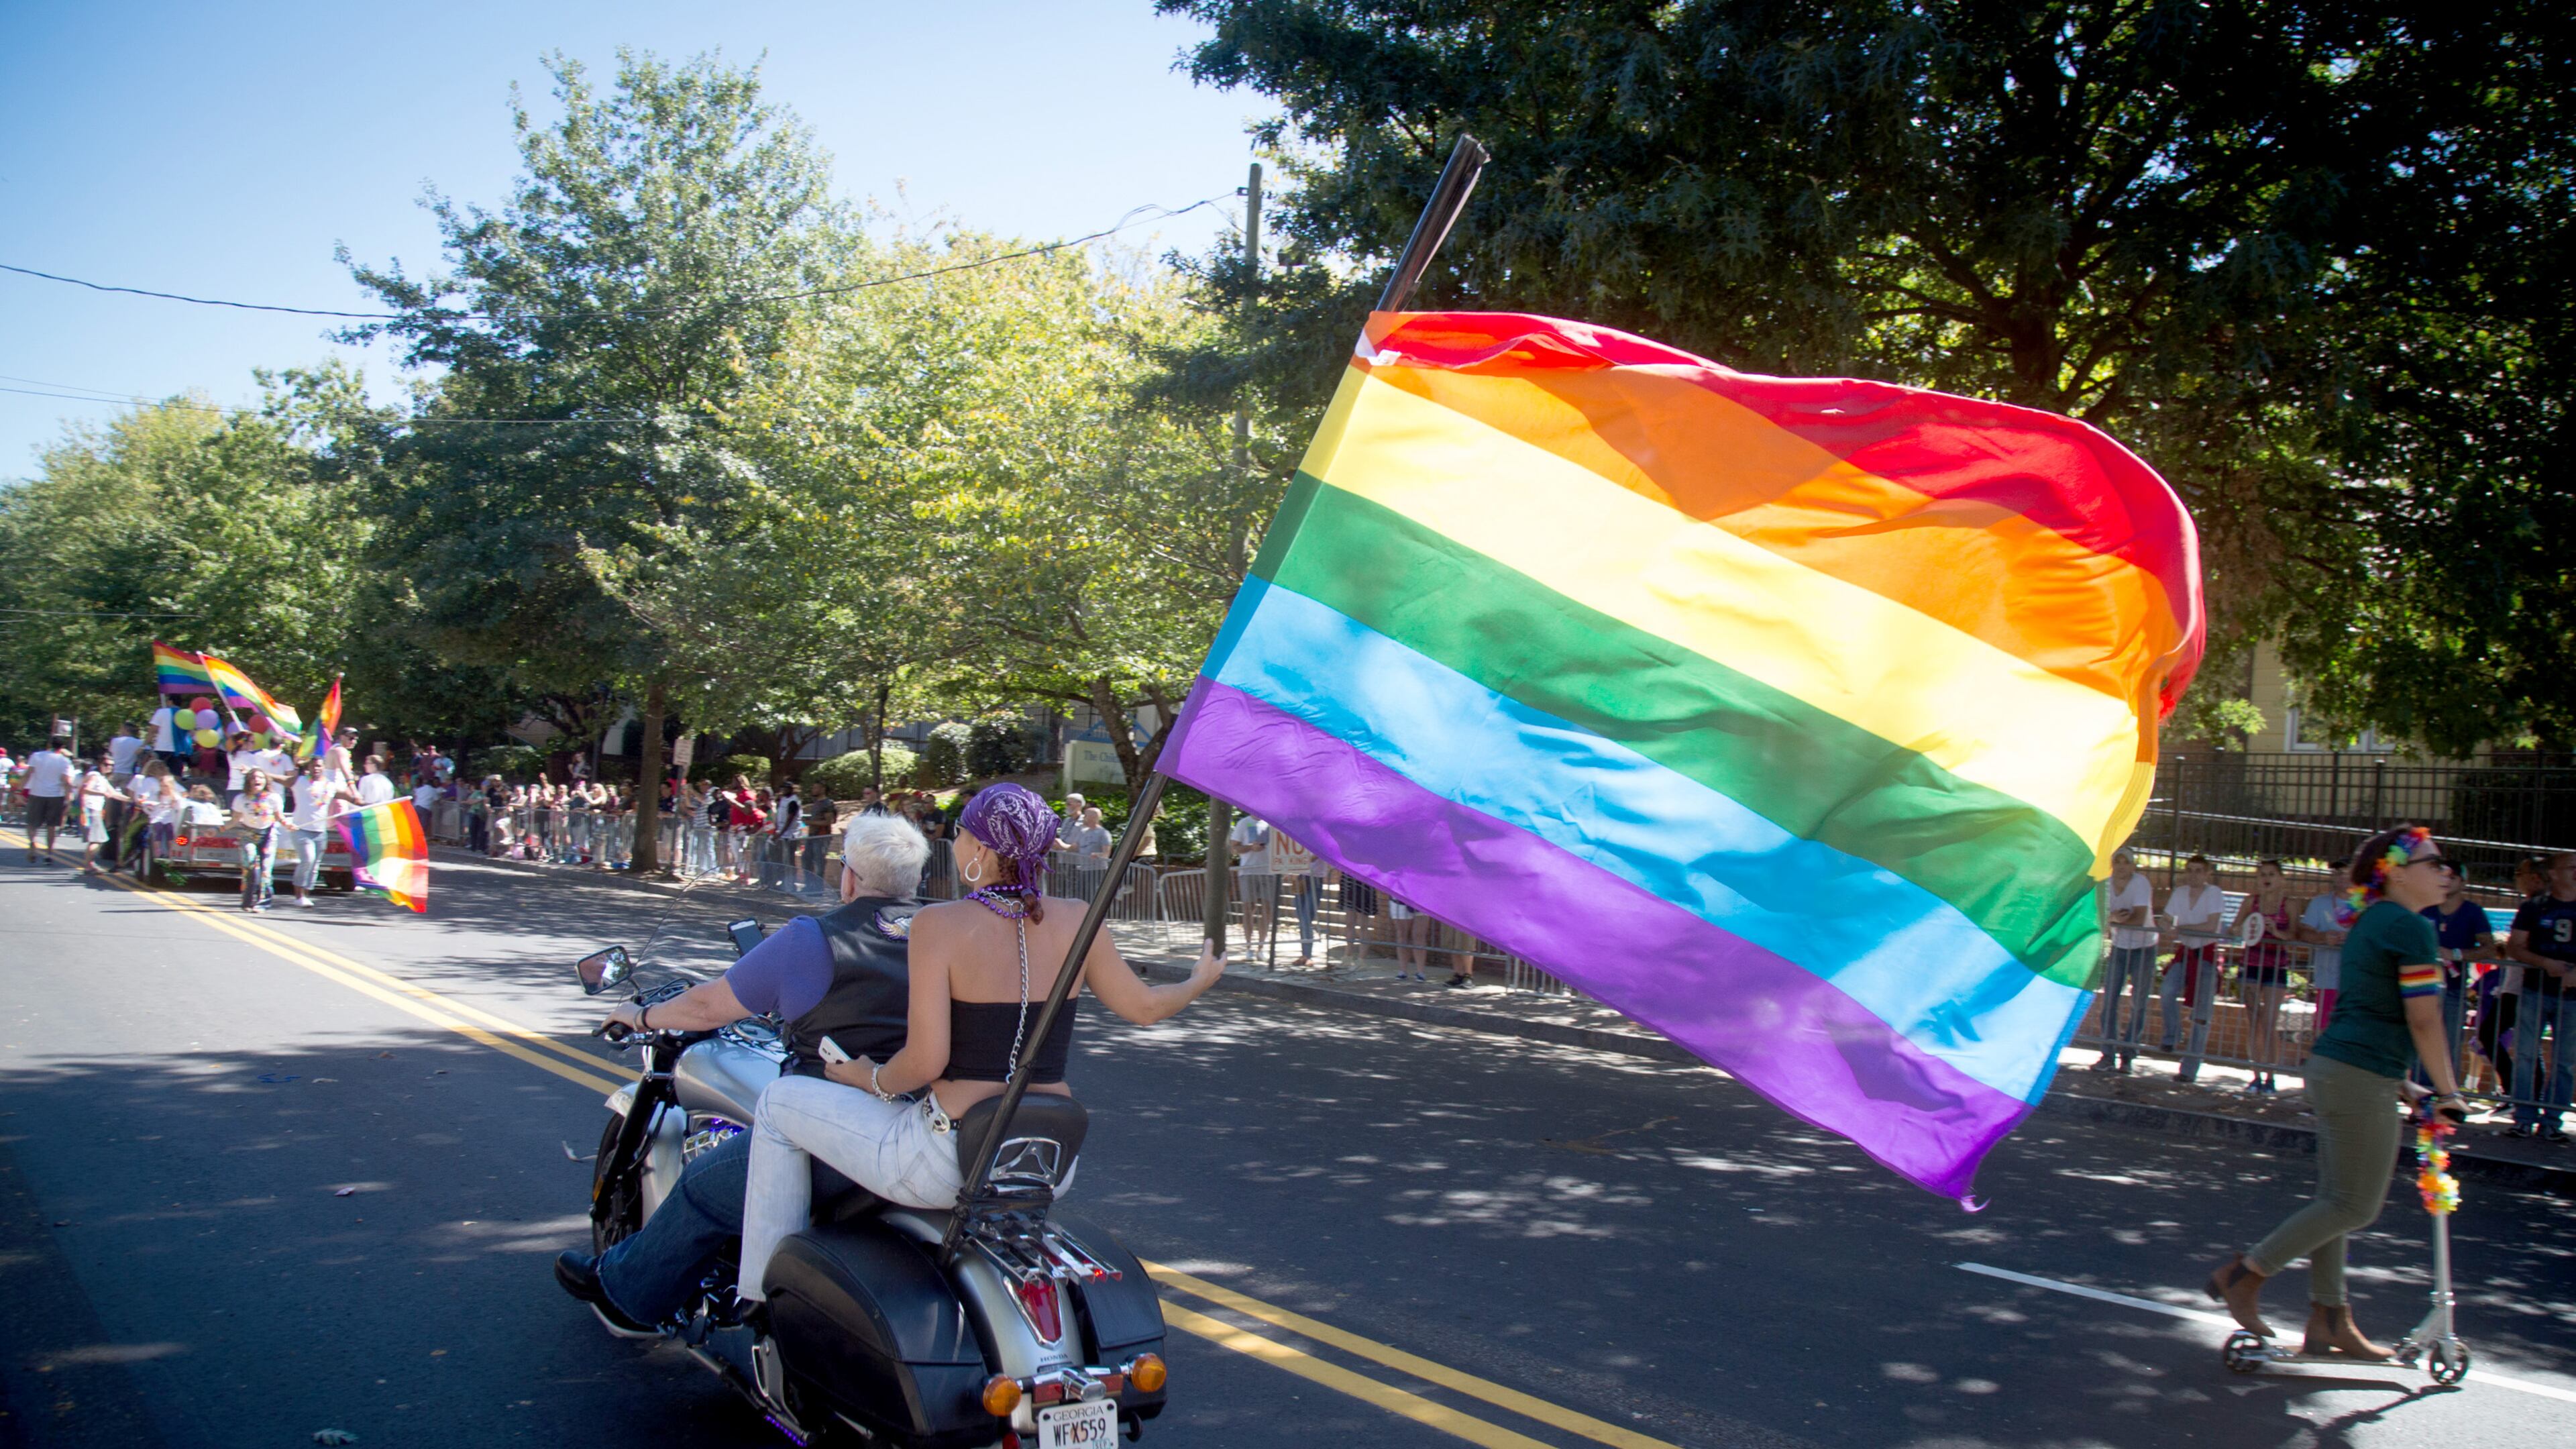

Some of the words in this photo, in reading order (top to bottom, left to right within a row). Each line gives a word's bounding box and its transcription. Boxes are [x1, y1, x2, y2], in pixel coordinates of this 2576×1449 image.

[2553, 918, 2573, 943] 9
[1040, 1353, 1068, 1362] HONDA
[1053, 1405, 1104, 1421] GEORGIA
[1053, 1417, 1106, 1447] WFX559
